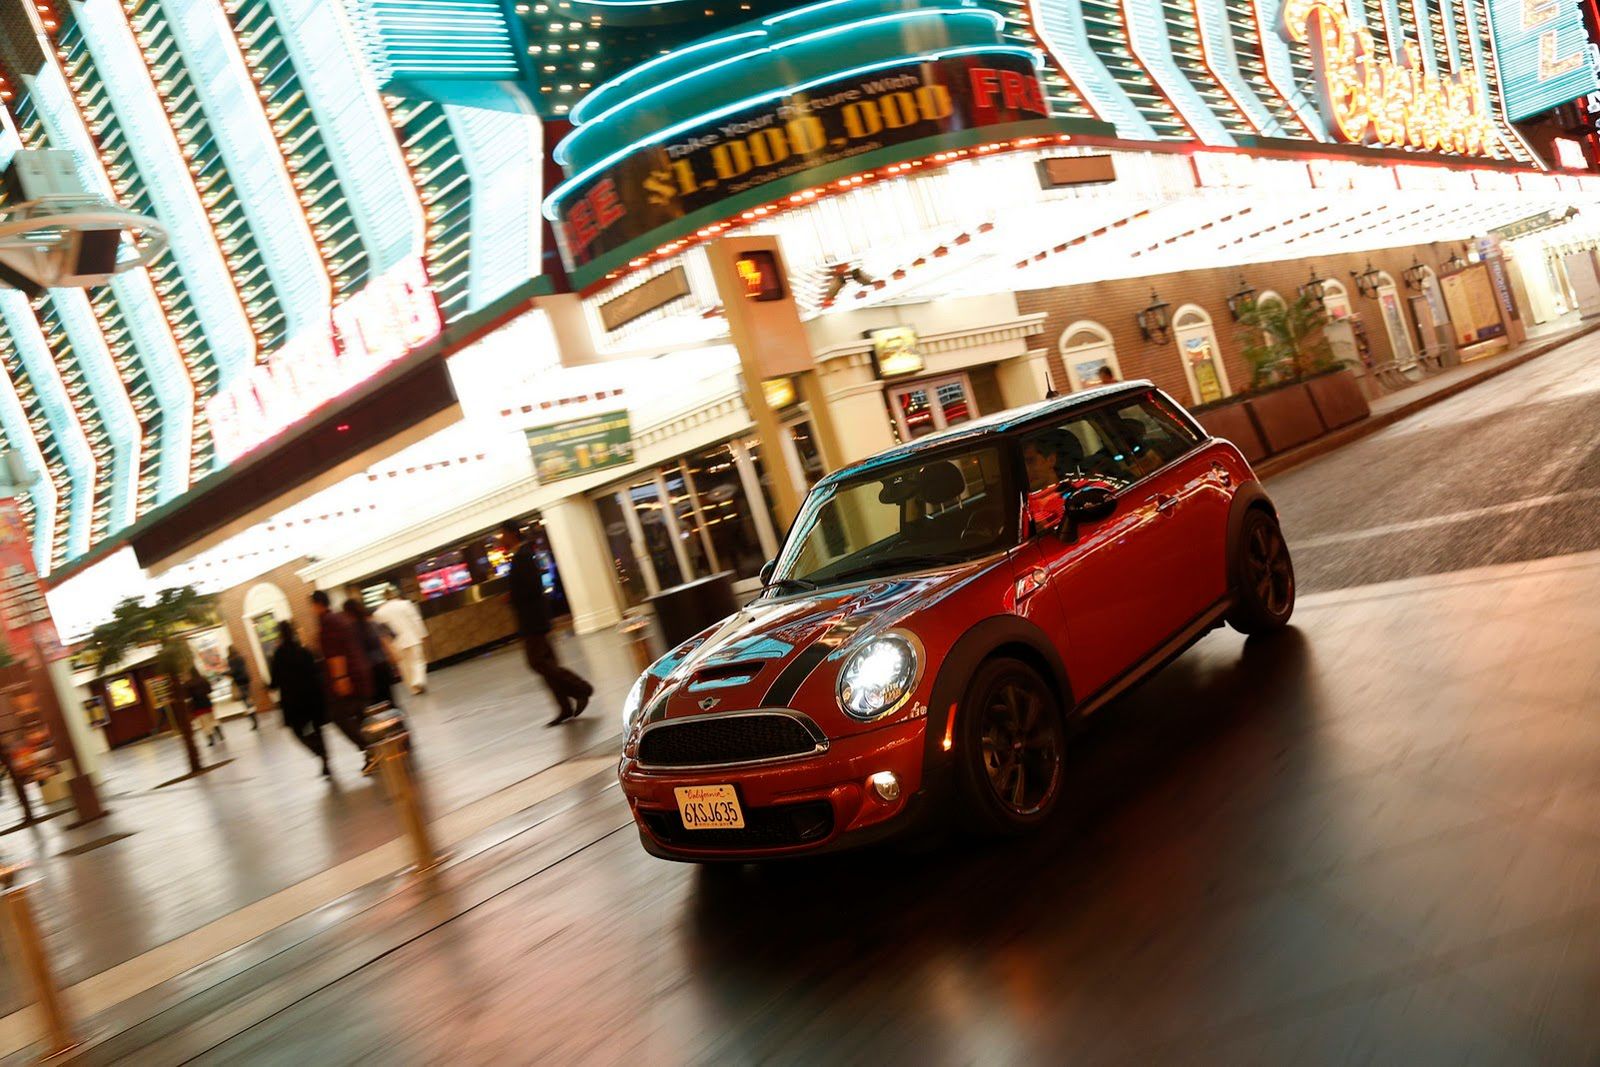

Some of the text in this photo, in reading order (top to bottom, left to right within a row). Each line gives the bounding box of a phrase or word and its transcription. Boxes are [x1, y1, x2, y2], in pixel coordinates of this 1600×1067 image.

[665, 133, 720, 159] Take
[717, 113, 776, 137] Your
[684, 802, 738, 823] 6XSJ635
